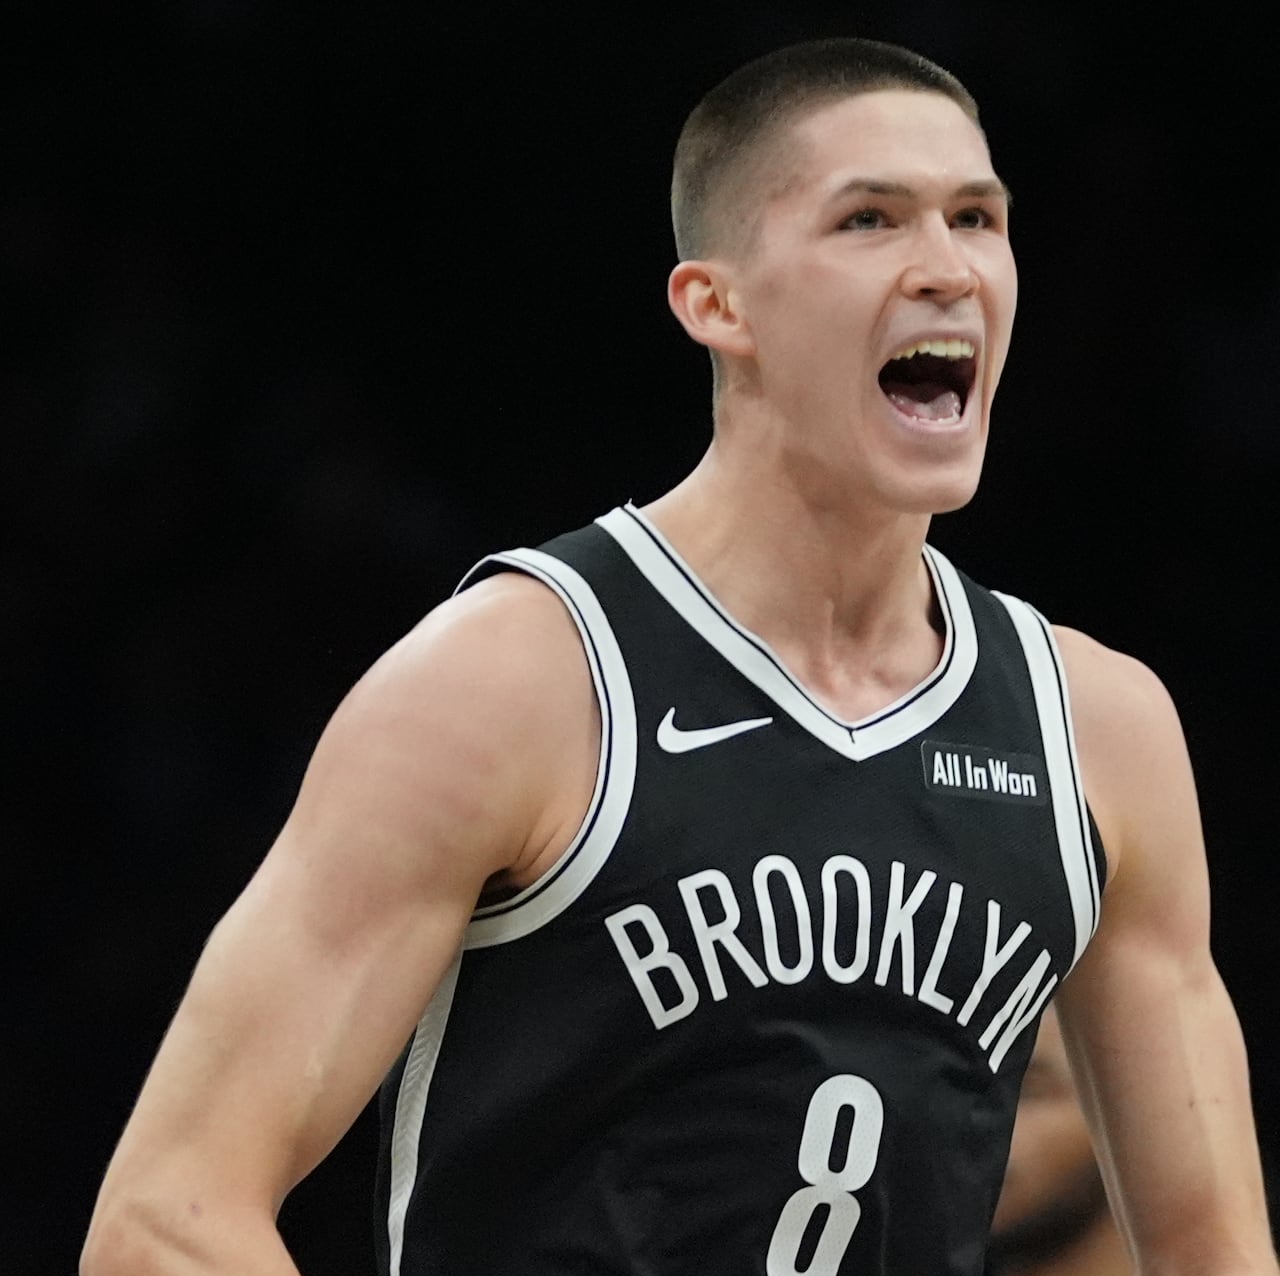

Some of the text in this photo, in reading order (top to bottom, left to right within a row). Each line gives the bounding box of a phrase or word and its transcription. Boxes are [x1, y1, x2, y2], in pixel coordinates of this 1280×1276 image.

[932, 751, 1037, 797] All In Won
[604, 854, 1059, 1074] BROOKLYN
